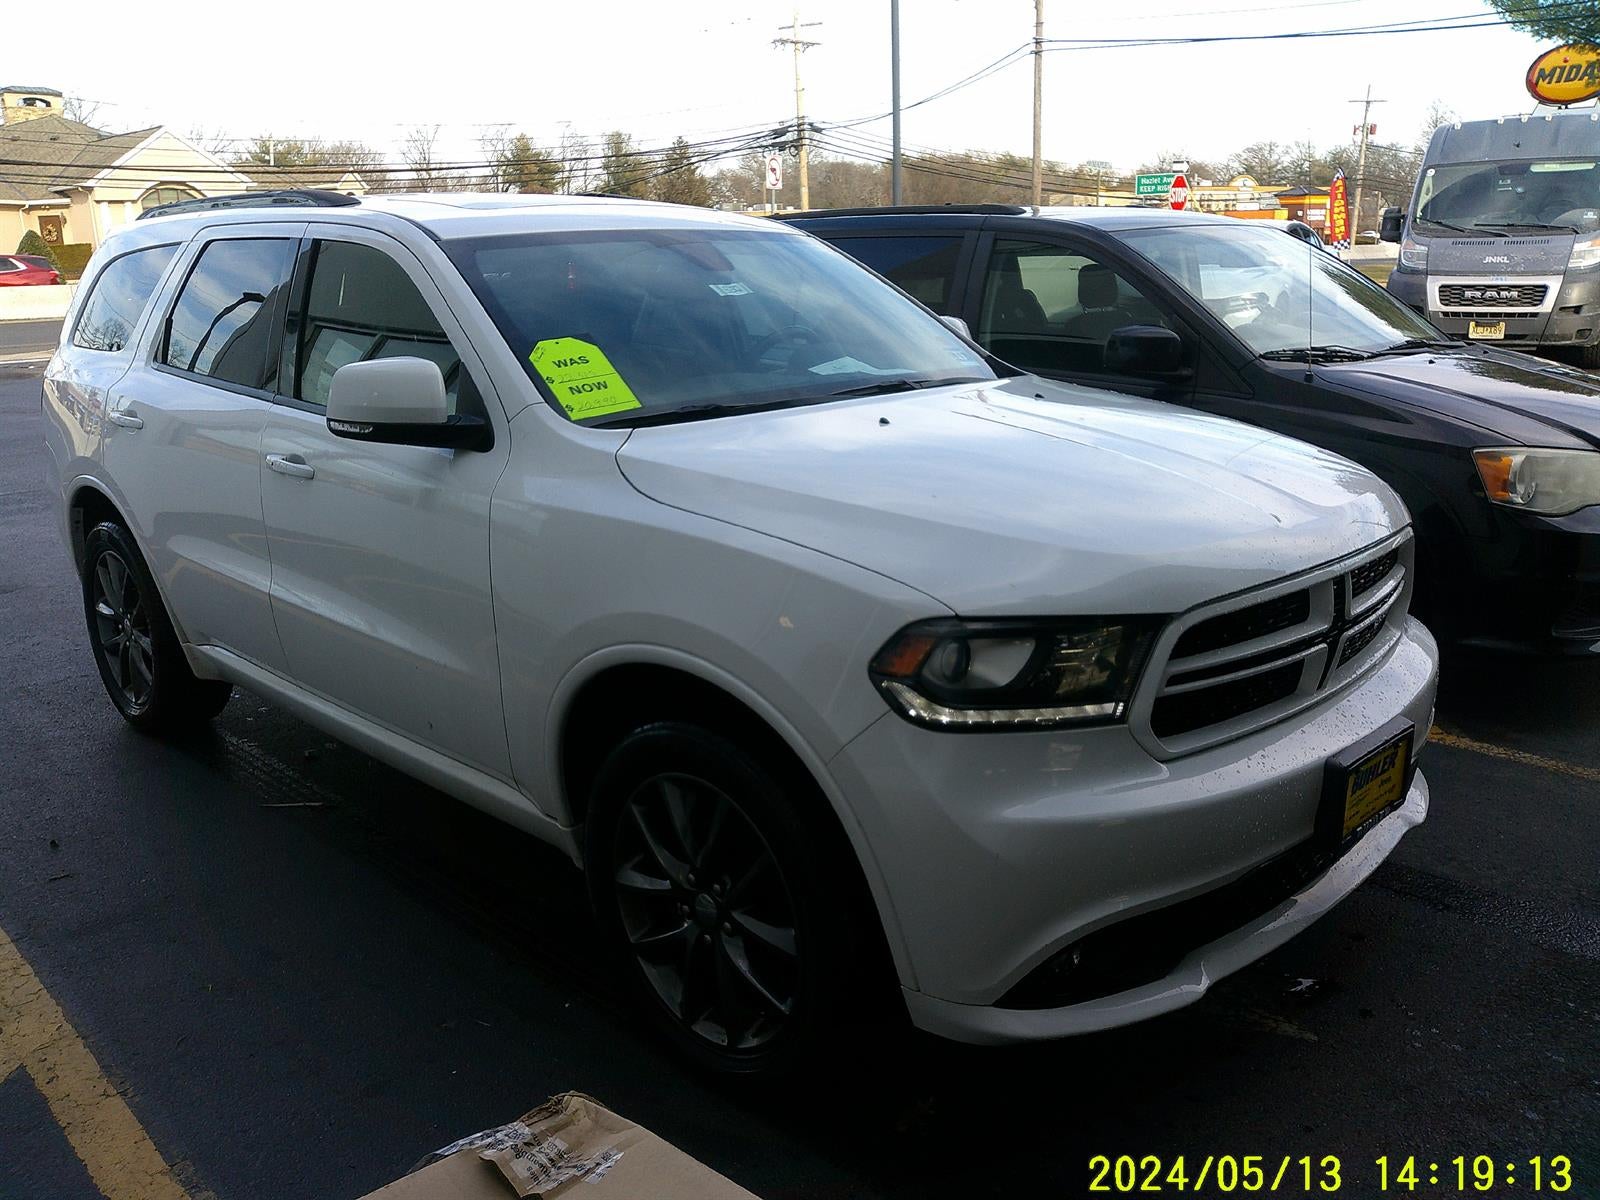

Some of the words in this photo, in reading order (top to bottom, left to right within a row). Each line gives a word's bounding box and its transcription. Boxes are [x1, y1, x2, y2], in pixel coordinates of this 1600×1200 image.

[1535, 61, 1600, 87] MIDA
[1141, 177, 1161, 185] Hazlet
[1170, 187, 1187, 203] STOP
[1333, 179, 1346, 239] ALIGNMENT
[1464, 291, 1519, 299] RAM
[552, 356, 590, 368] WAS
[568, 381, 609, 395] NOW
